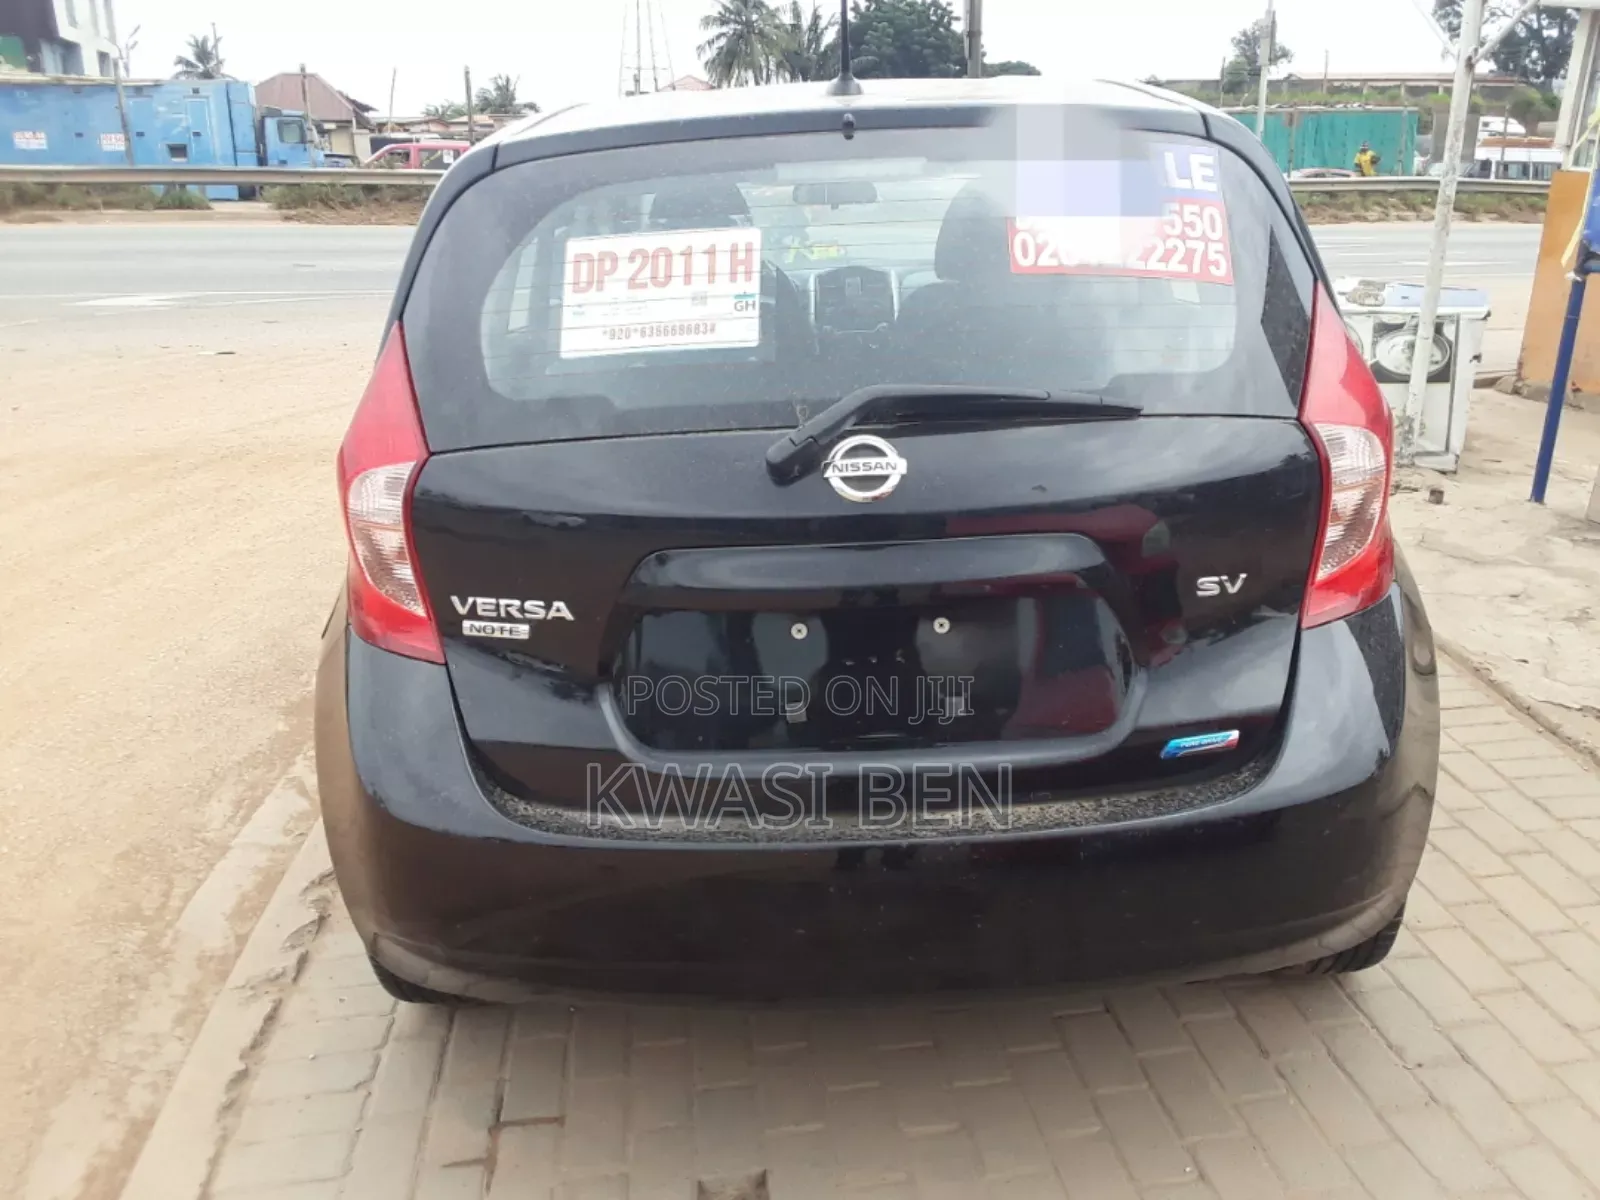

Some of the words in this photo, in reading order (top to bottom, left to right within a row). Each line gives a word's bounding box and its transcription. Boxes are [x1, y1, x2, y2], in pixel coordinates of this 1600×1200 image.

[1164, 152, 1218, 192] LE
[572, 251, 618, 294] DP
[627, 244, 716, 290] 2011
[730, 241, 753, 283] H
[734, 300, 756, 312] GH
[832, 461, 897, 473] NISSAN
[1196, 573, 1248, 597] SV
[450, 595, 575, 621] VERSA
[469, 623, 522, 636] NOTE
